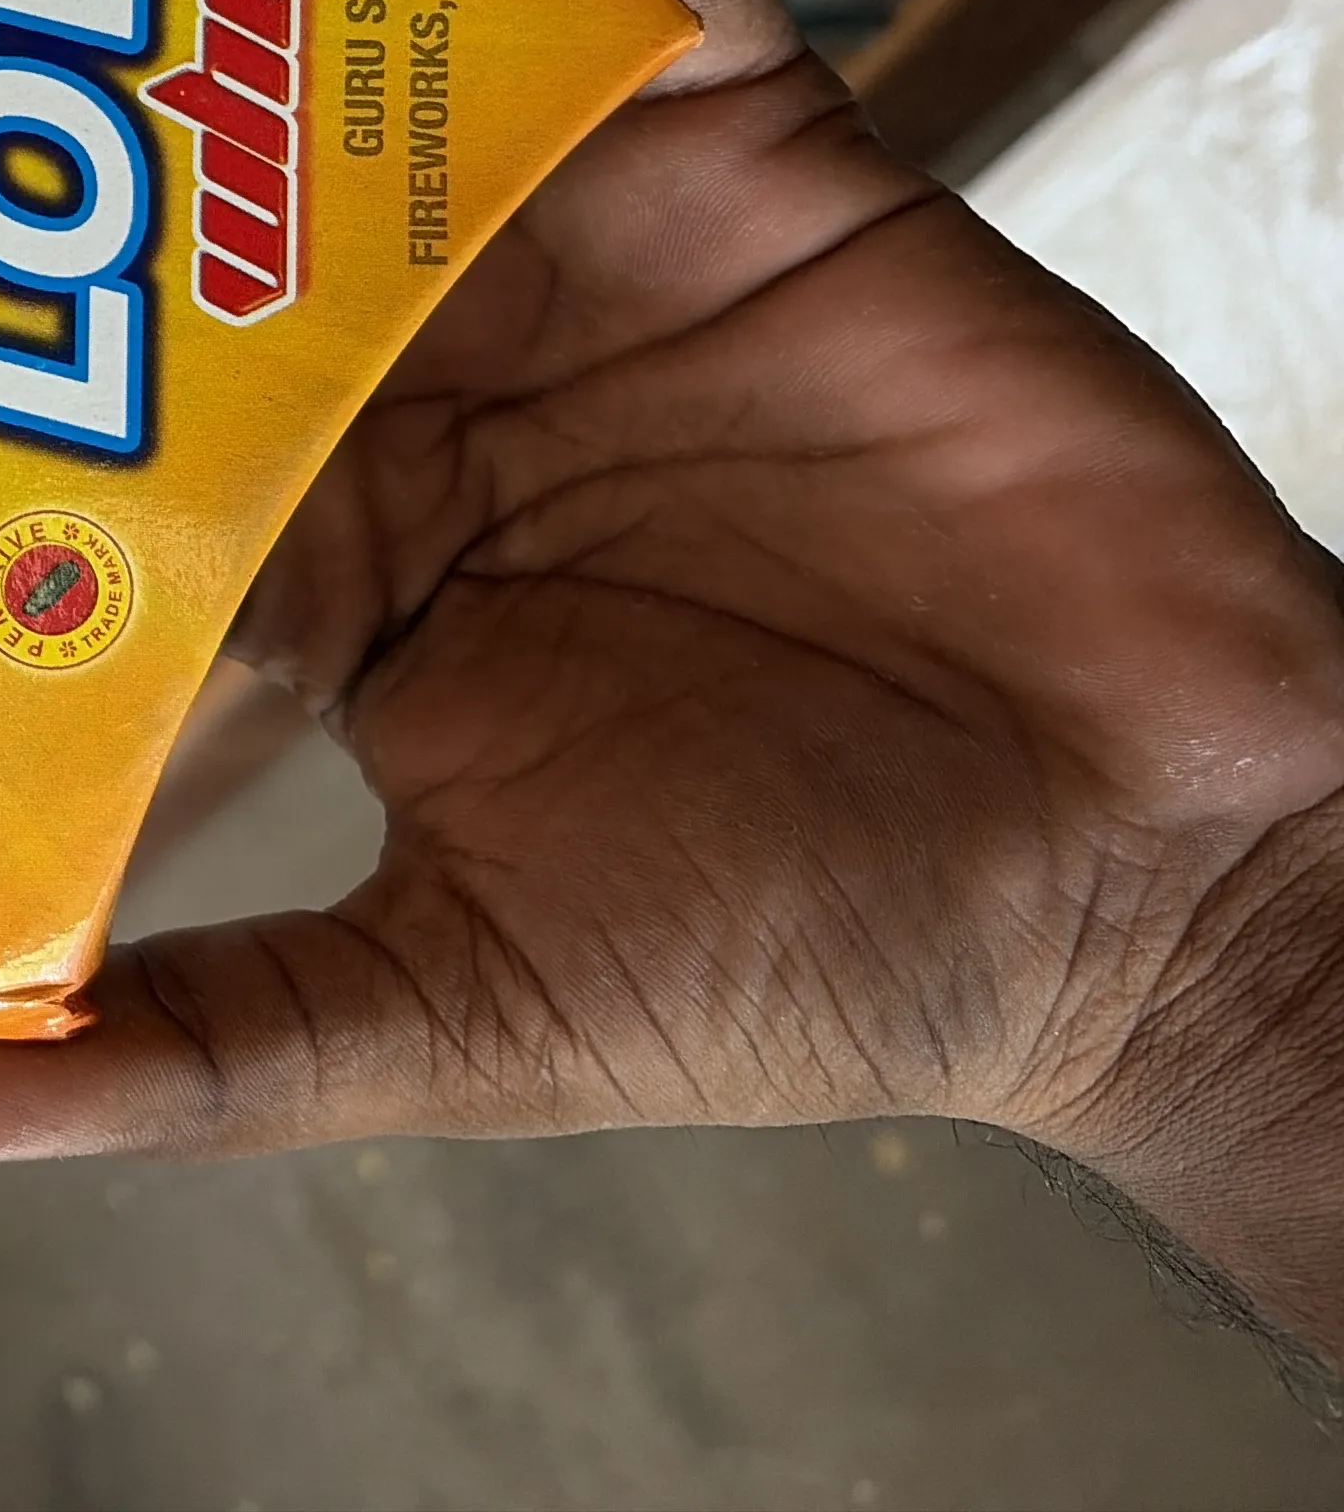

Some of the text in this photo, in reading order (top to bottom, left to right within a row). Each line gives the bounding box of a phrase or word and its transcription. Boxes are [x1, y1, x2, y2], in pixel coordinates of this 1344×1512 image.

[343, 36, 389, 158] GURU
[408, 0, 459, 266] FIREWORKS,
[82, 533, 122, 649] TRADE MARK
